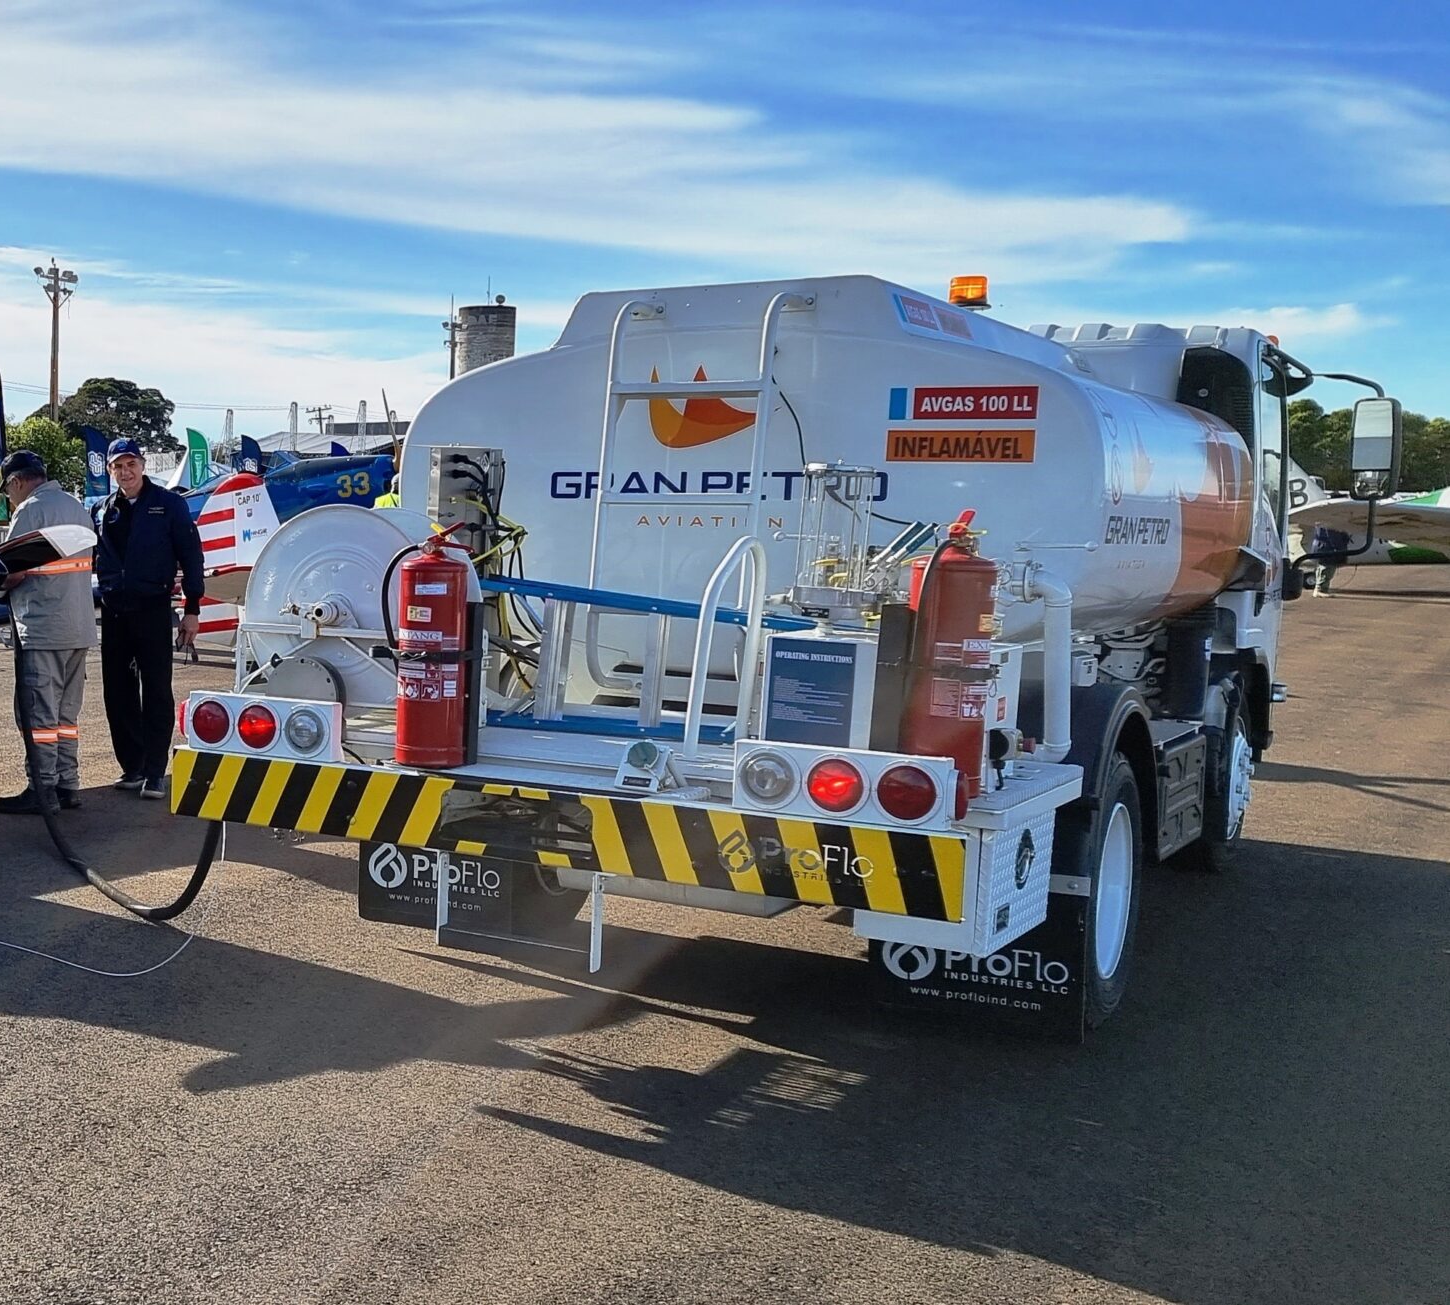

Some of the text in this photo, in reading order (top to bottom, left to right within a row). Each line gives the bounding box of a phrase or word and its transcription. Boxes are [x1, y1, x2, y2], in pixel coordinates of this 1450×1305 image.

[920, 395, 1033, 412] AVGAS 100 LL
[894, 431, 1022, 459] INFLAMÁVEL
[336, 471, 370, 498] 33
[637, 515, 783, 528] AVIATIN
[1104, 515, 1171, 545] GRAN PETRO
[775, 650, 854, 664] OPERATING INSTRUCTIONS
[759, 836, 874, 878] ProFlo
[412, 879, 500, 898] INDURIES LLC
[388, 892, 482, 912] www.proflnd.com
[944, 949, 1069, 984] ProFlo
[943, 971, 1069, 995] INDUSTRIES LLC
[910, 986, 1042, 1011] www.profloind.com
